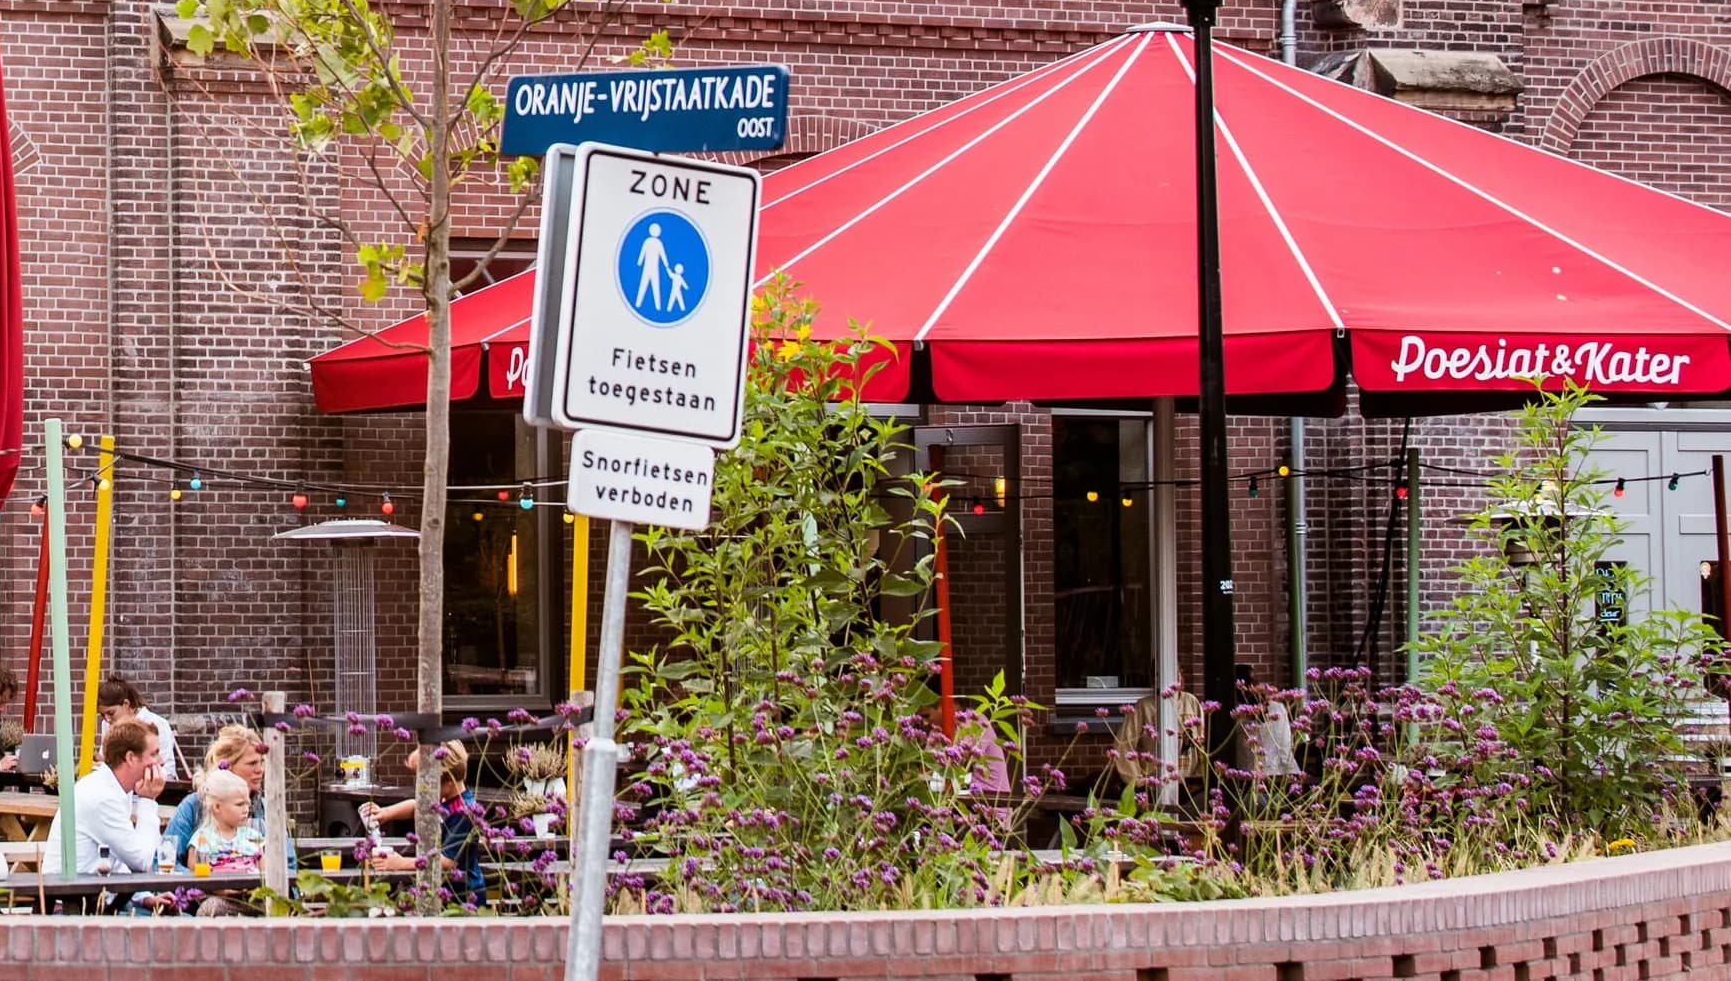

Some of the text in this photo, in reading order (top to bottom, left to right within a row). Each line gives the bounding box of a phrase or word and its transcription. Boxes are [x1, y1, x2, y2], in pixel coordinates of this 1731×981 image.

[515, 75, 776, 123] ORANJE-VRIJSTAATKADE
[737, 117, 774, 138] OOST
[630, 170, 711, 205] ZONE
[612, 347, 697, 378] Fietsen
[589, 376, 716, 411] toegestaan
[582, 450, 708, 486] Snorfietsen
[596, 485, 694, 513] verboden
